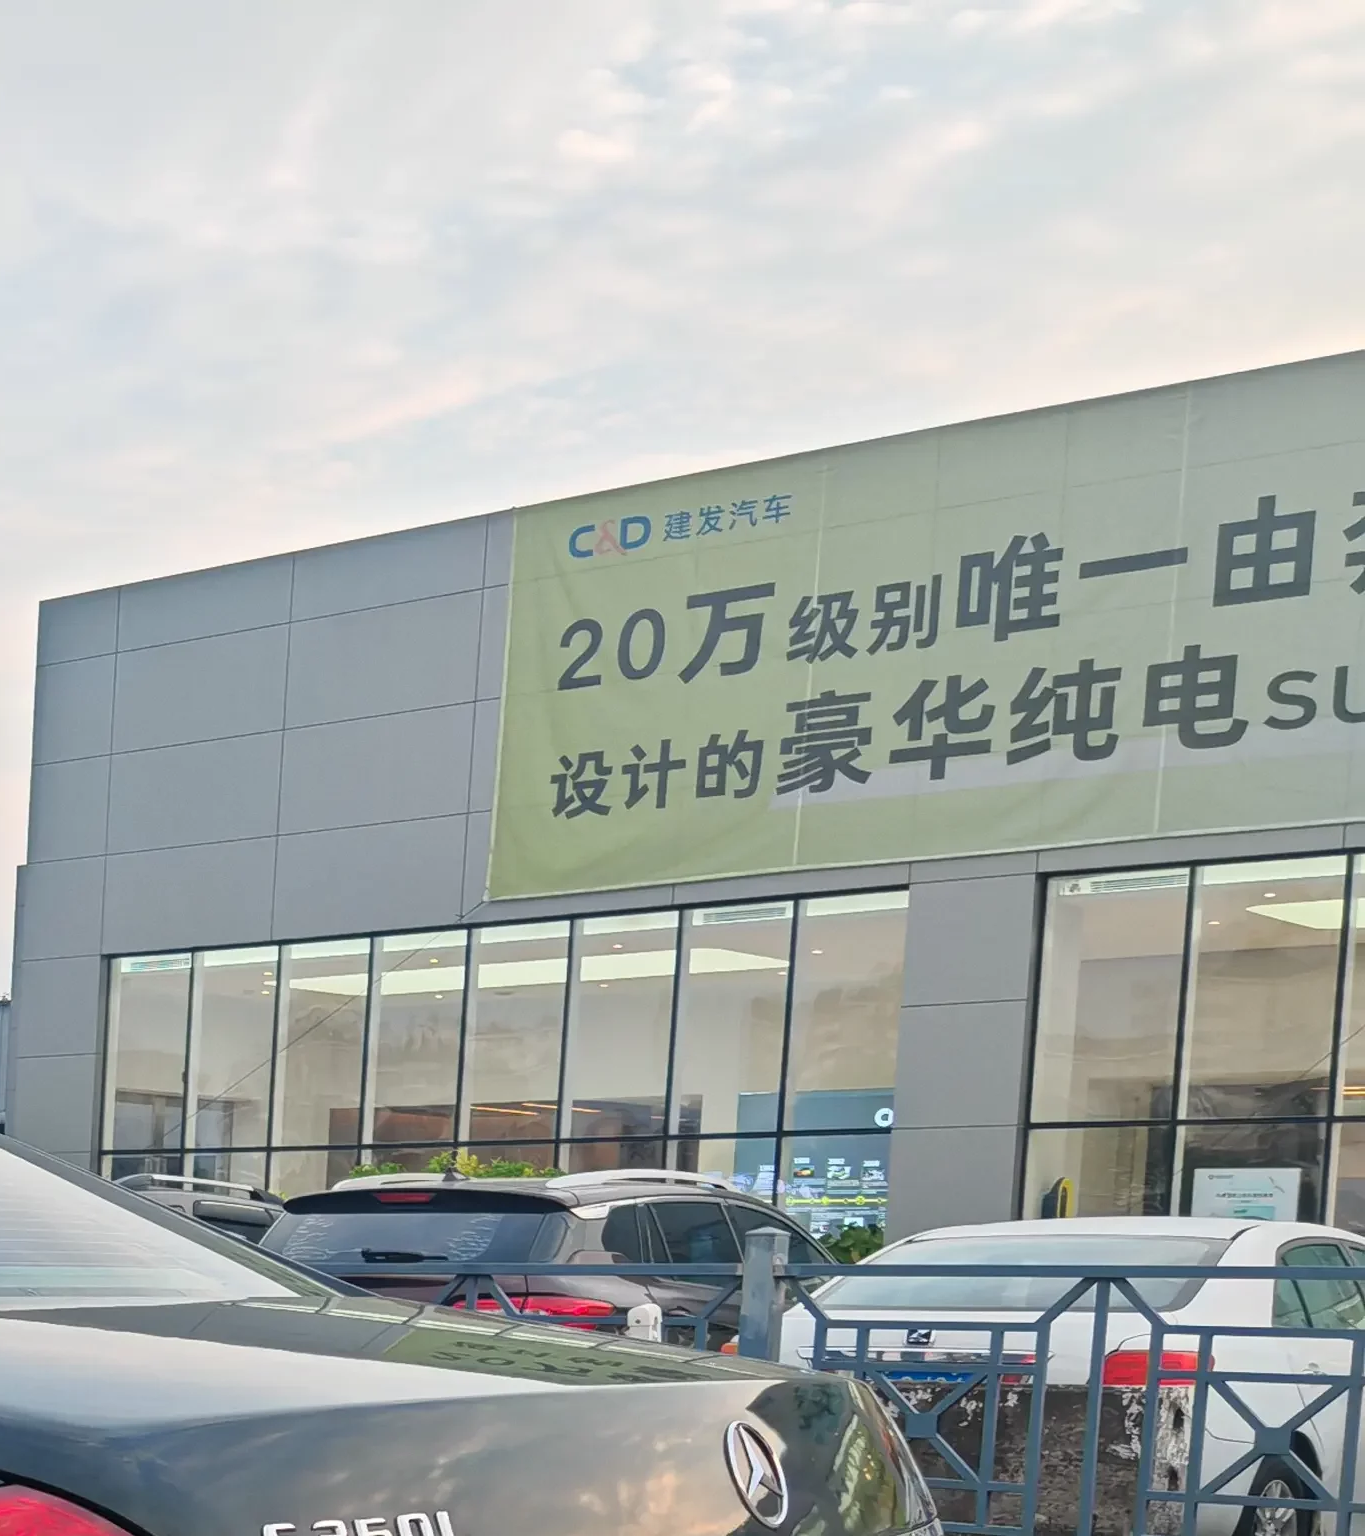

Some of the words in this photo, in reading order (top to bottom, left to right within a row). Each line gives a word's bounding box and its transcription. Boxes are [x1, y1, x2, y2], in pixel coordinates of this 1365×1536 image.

[556, 490, 1365, 691] 20万级别唯一由
[568, 515, 652, 558] C&D
[662, 494, 793, 542] 建发汽车
